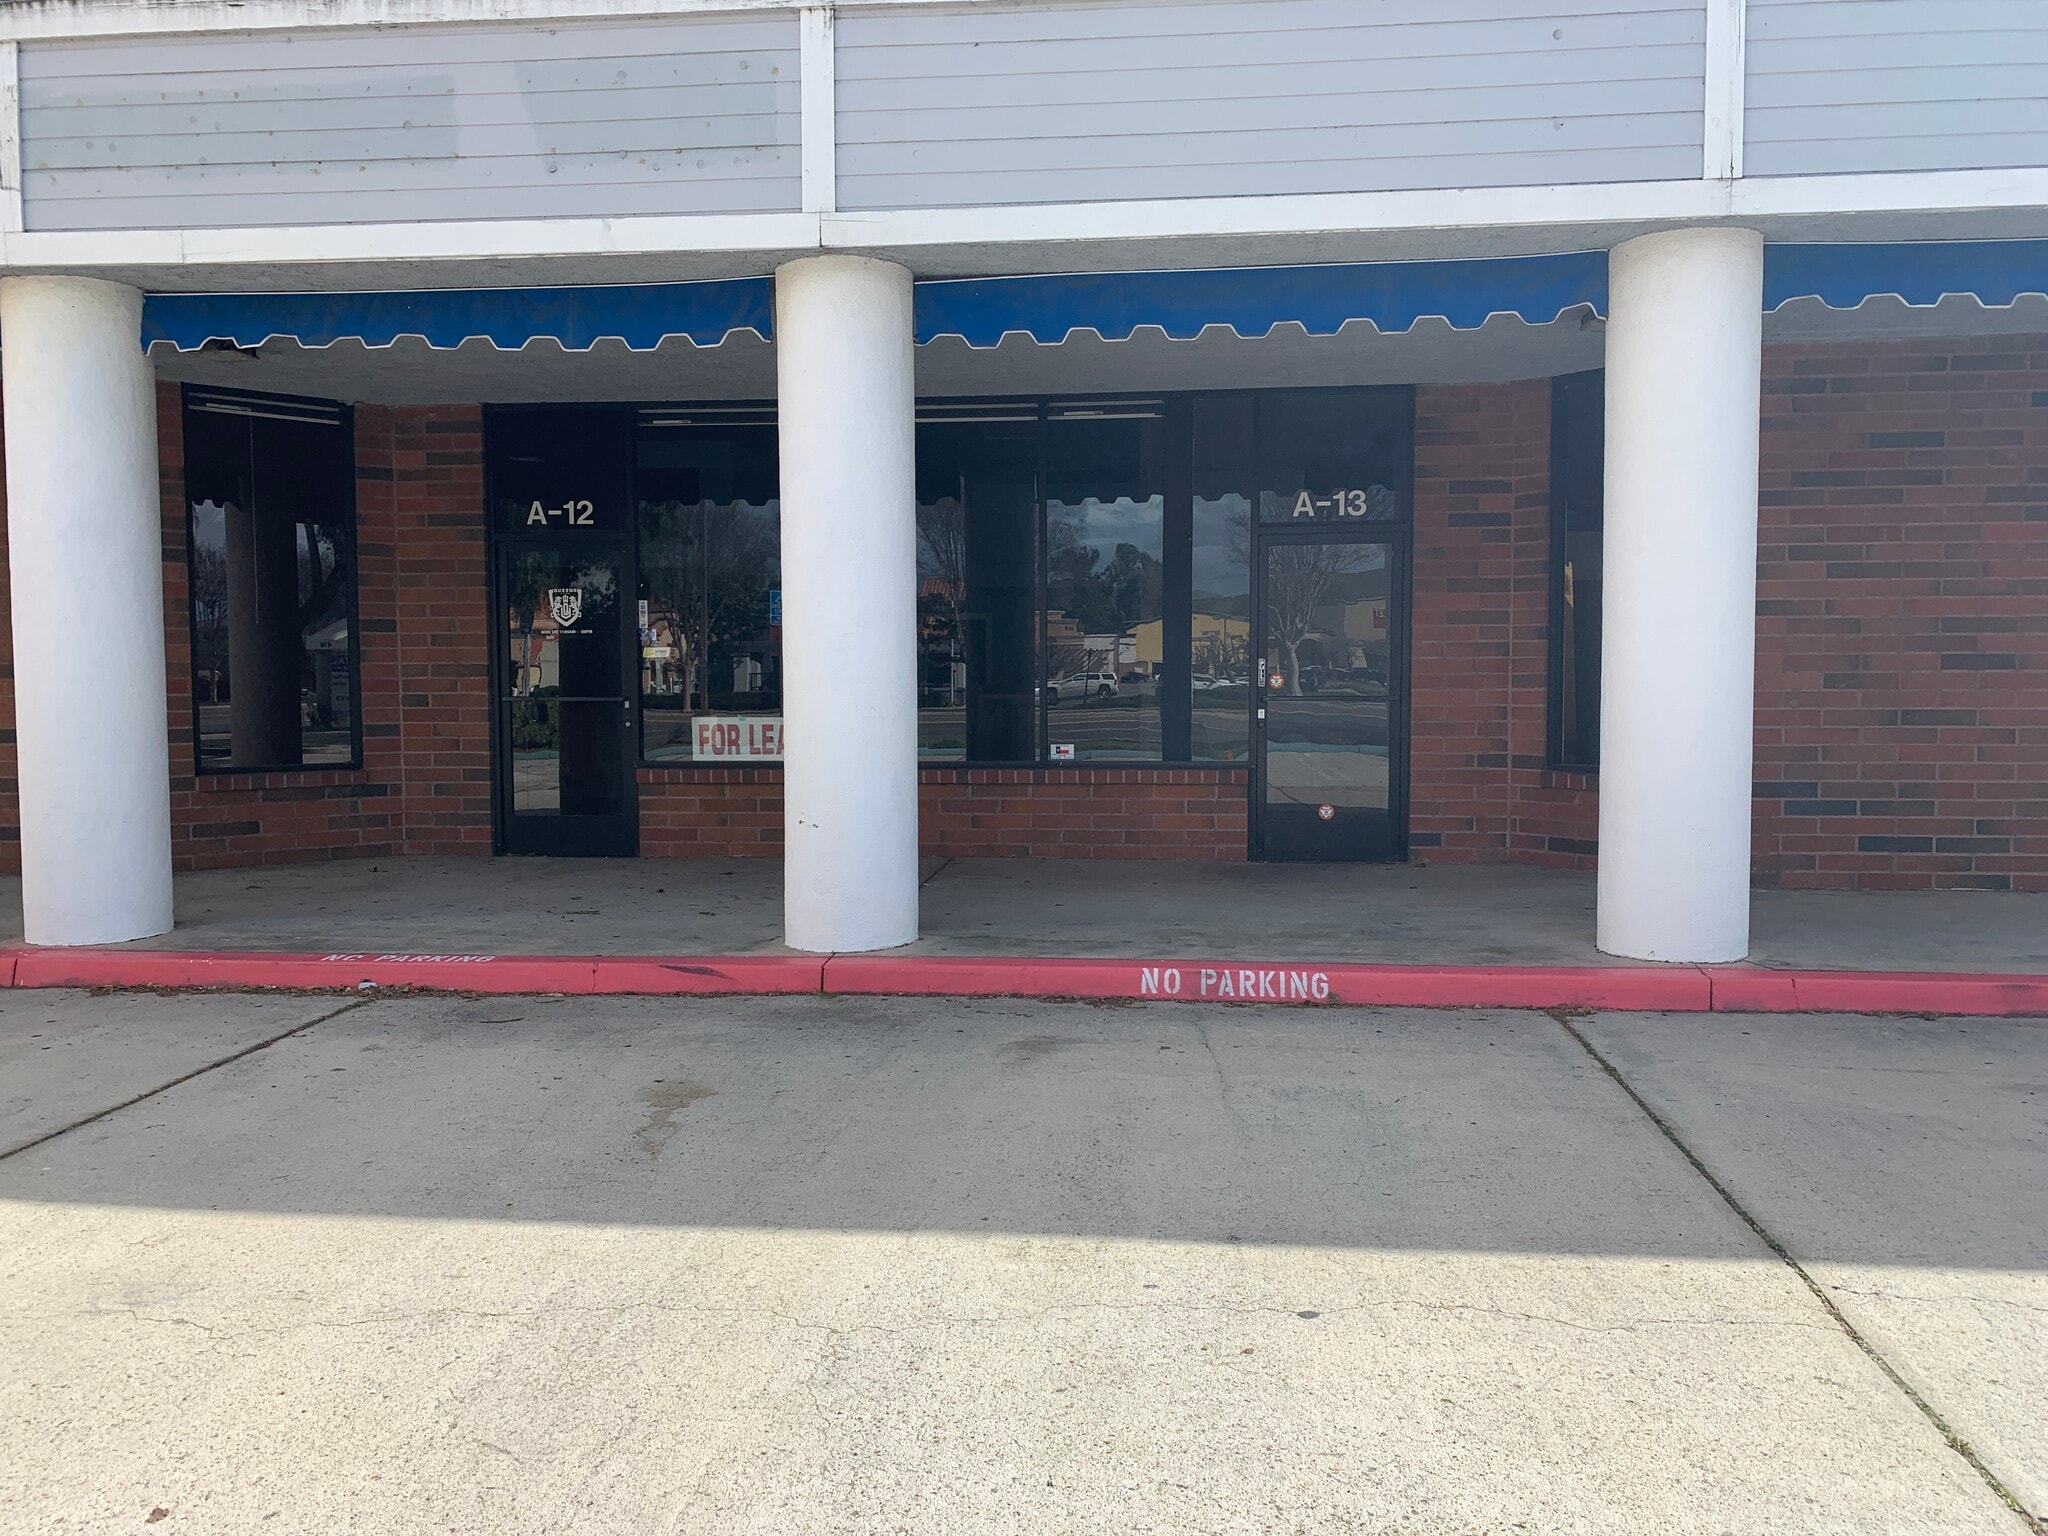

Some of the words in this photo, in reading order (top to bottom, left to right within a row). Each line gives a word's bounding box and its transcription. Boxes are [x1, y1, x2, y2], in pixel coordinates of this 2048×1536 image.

[526, 500, 594, 525] A-12
[1292, 489, 1367, 517] A-13
[699, 724, 741, 755] FOR
[373, 954, 496, 963] PARKING
[1141, 967, 1181, 995] NO
[1200, 968, 1329, 999] PARKING
